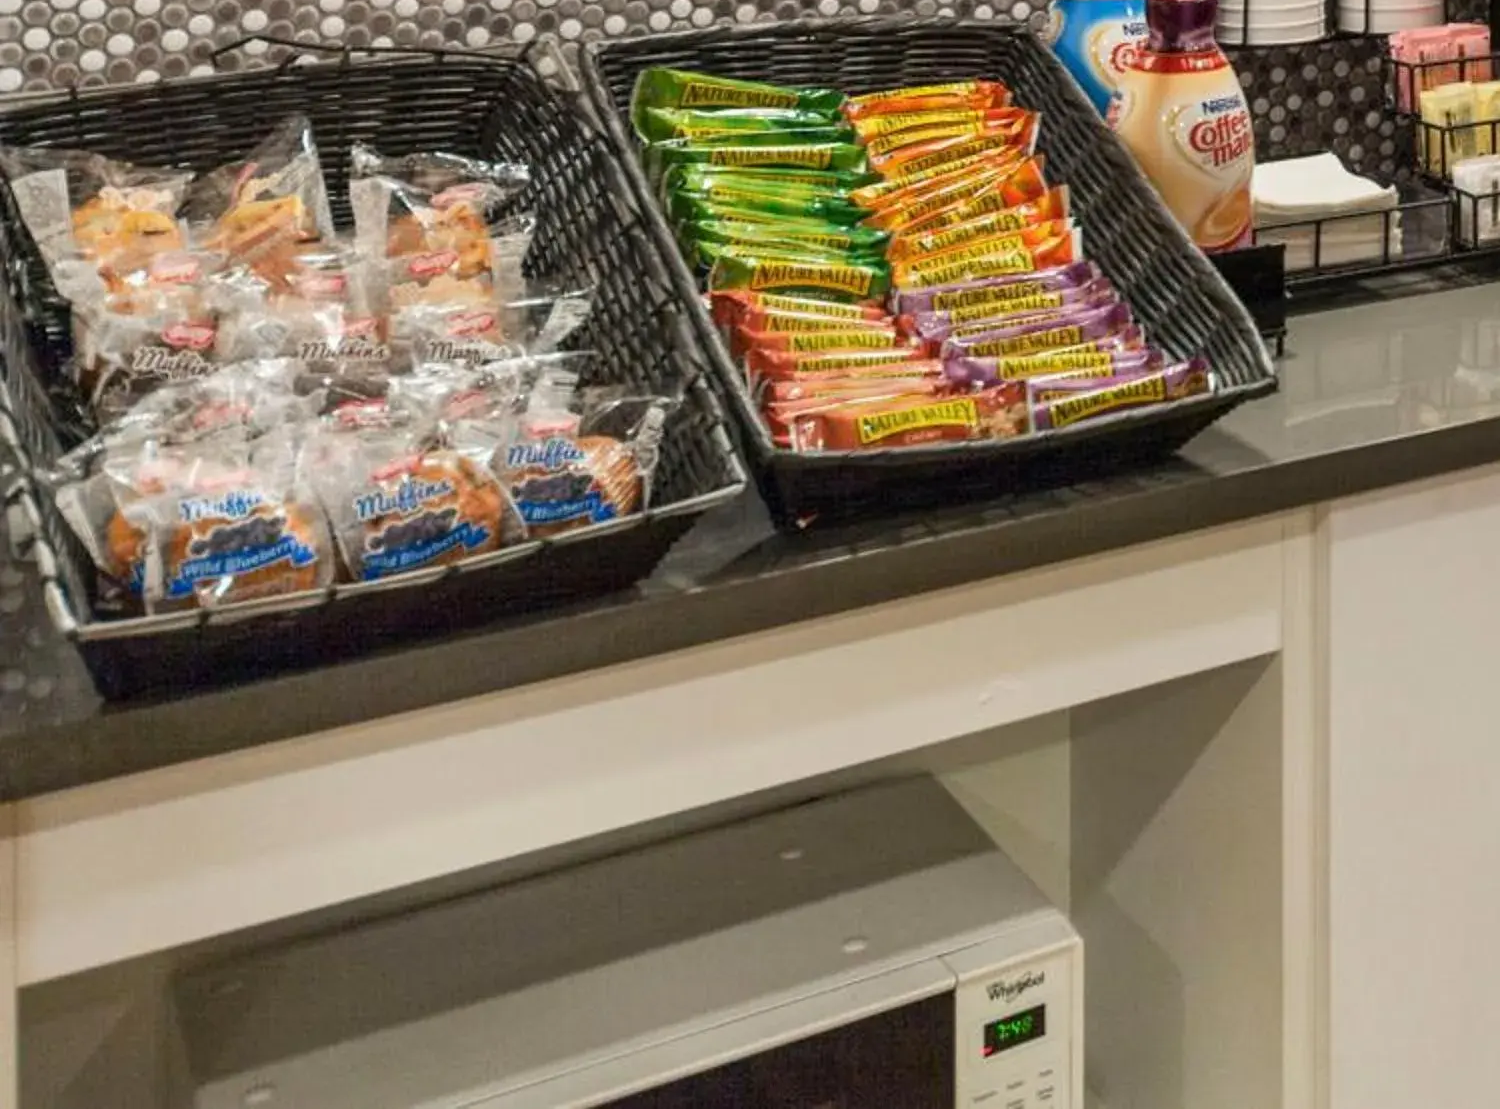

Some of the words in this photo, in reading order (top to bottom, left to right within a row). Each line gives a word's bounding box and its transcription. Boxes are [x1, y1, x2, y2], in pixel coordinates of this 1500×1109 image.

[684, 83, 744, 106] NATURE
[1213, 132, 1251, 167] mat
[755, 265, 815, 288] NATURE
[819, 267, 868, 292] VALLEY
[792, 333, 843, 351] NATURE
[1003, 356, 1053, 377] NATURE
[1056, 352, 1110, 371] VALLEY
[1053, 392, 1109, 422] NATURE
[1112, 377, 1163, 402] VALLEY
[863, 407, 919, 433] NATURE
[922, 400, 974, 423] VALLEY
